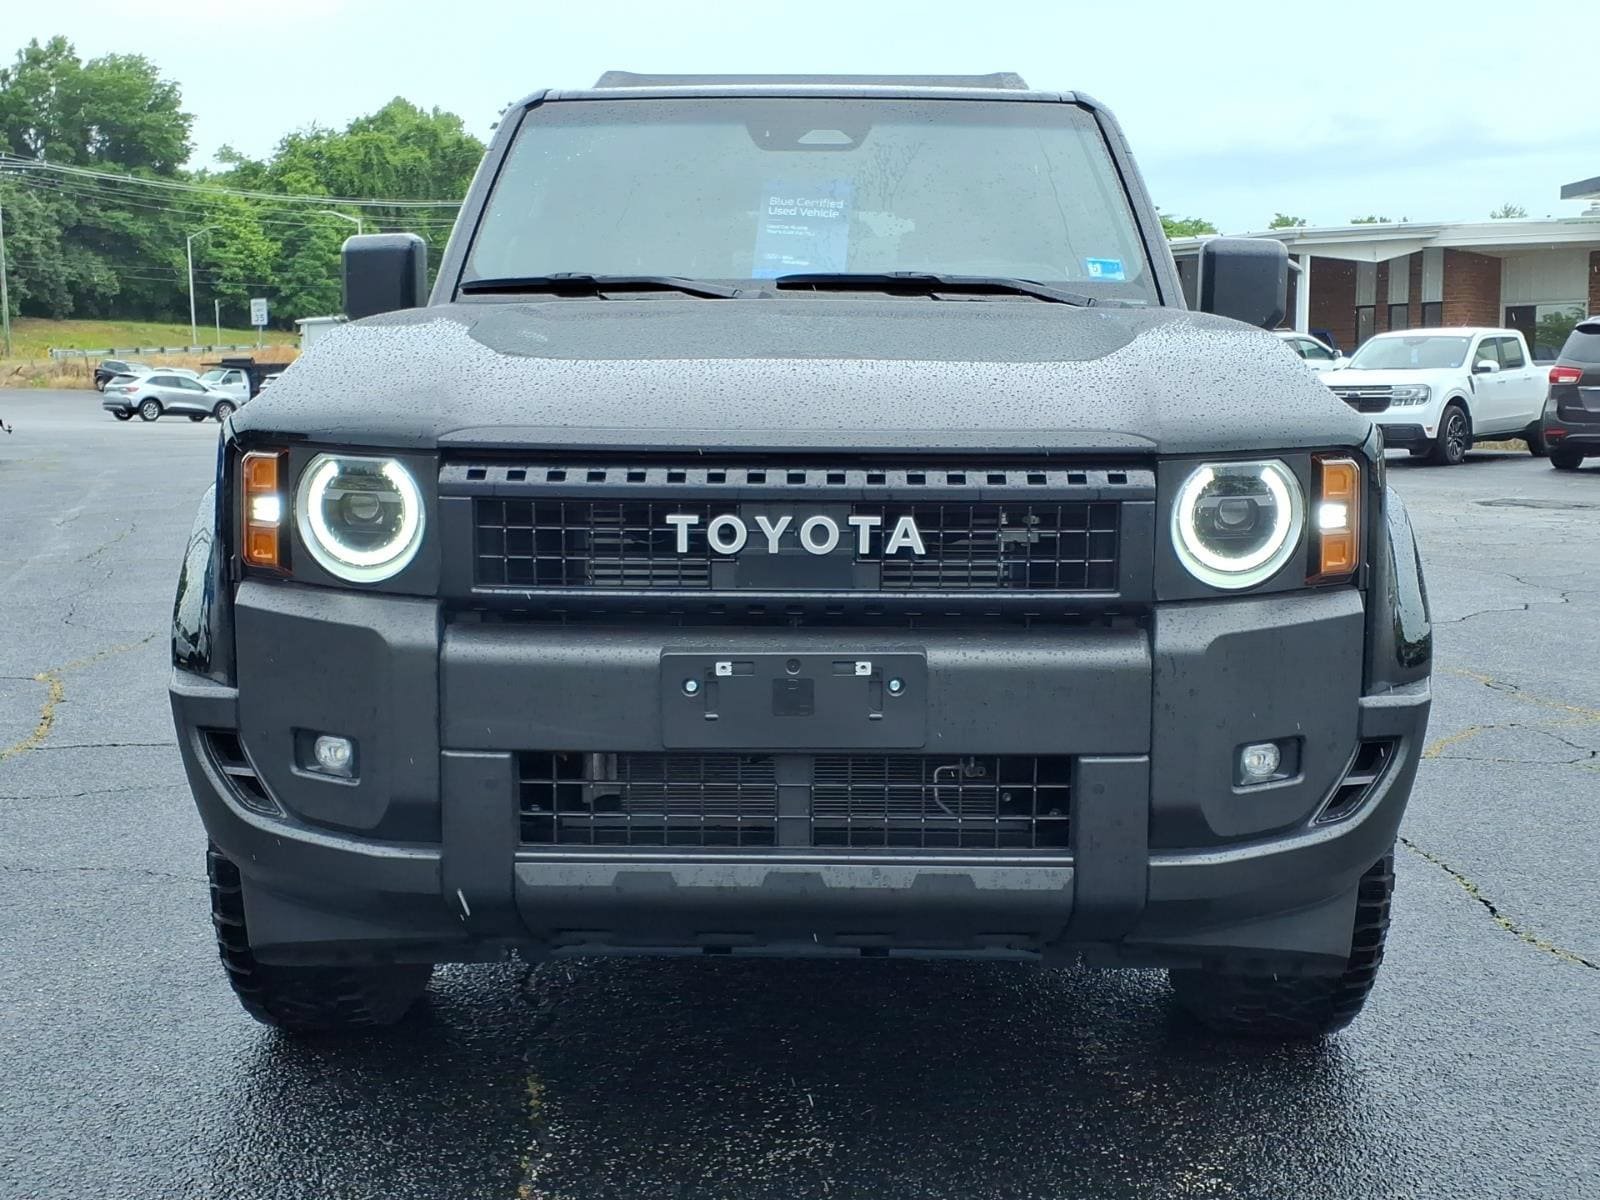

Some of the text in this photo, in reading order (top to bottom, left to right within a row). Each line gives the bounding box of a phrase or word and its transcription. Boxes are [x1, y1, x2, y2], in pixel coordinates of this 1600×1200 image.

[769, 196, 844, 209] Blue Certified
[768, 206, 840, 218] Used Vehicle
[666, 514, 926, 555] TOYOTA
